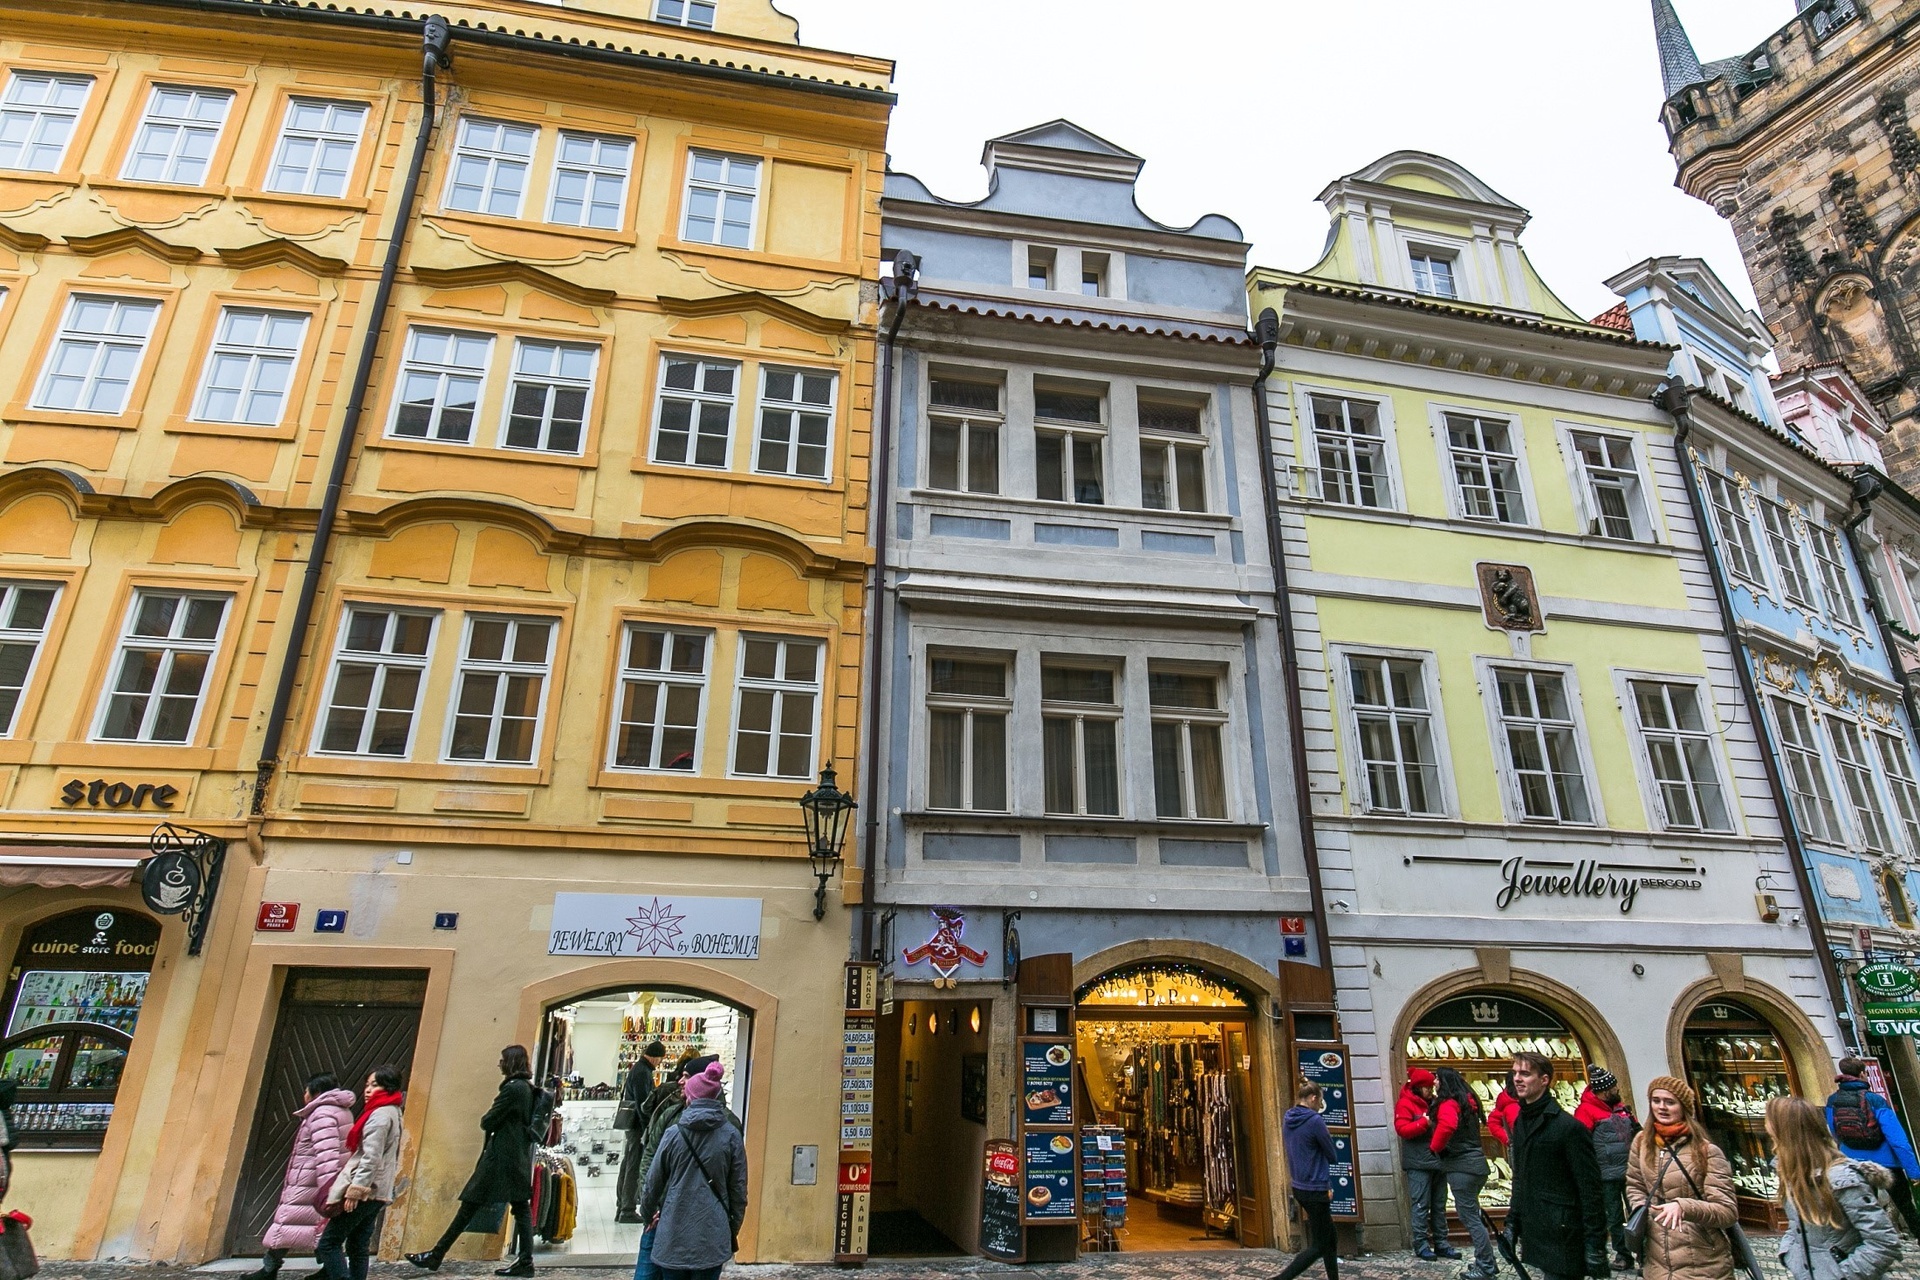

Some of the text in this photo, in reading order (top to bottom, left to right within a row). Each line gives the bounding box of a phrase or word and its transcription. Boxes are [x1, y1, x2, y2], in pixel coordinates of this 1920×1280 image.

[60, 778, 179, 808] store
[1496, 856, 1703, 915] Jewellery BERGOLD
[31, 939, 158, 955] wine store food
[549, 928, 759, 957] JEWELRY by BOHEMIA
[1860, 964, 1910, 976] TOURIST INFO
[839, 1183, 870, 1191] COMMISSION
[840, 1195, 850, 1254] WECHSEL
[856, 1195, 865, 1254] CAMBIO
